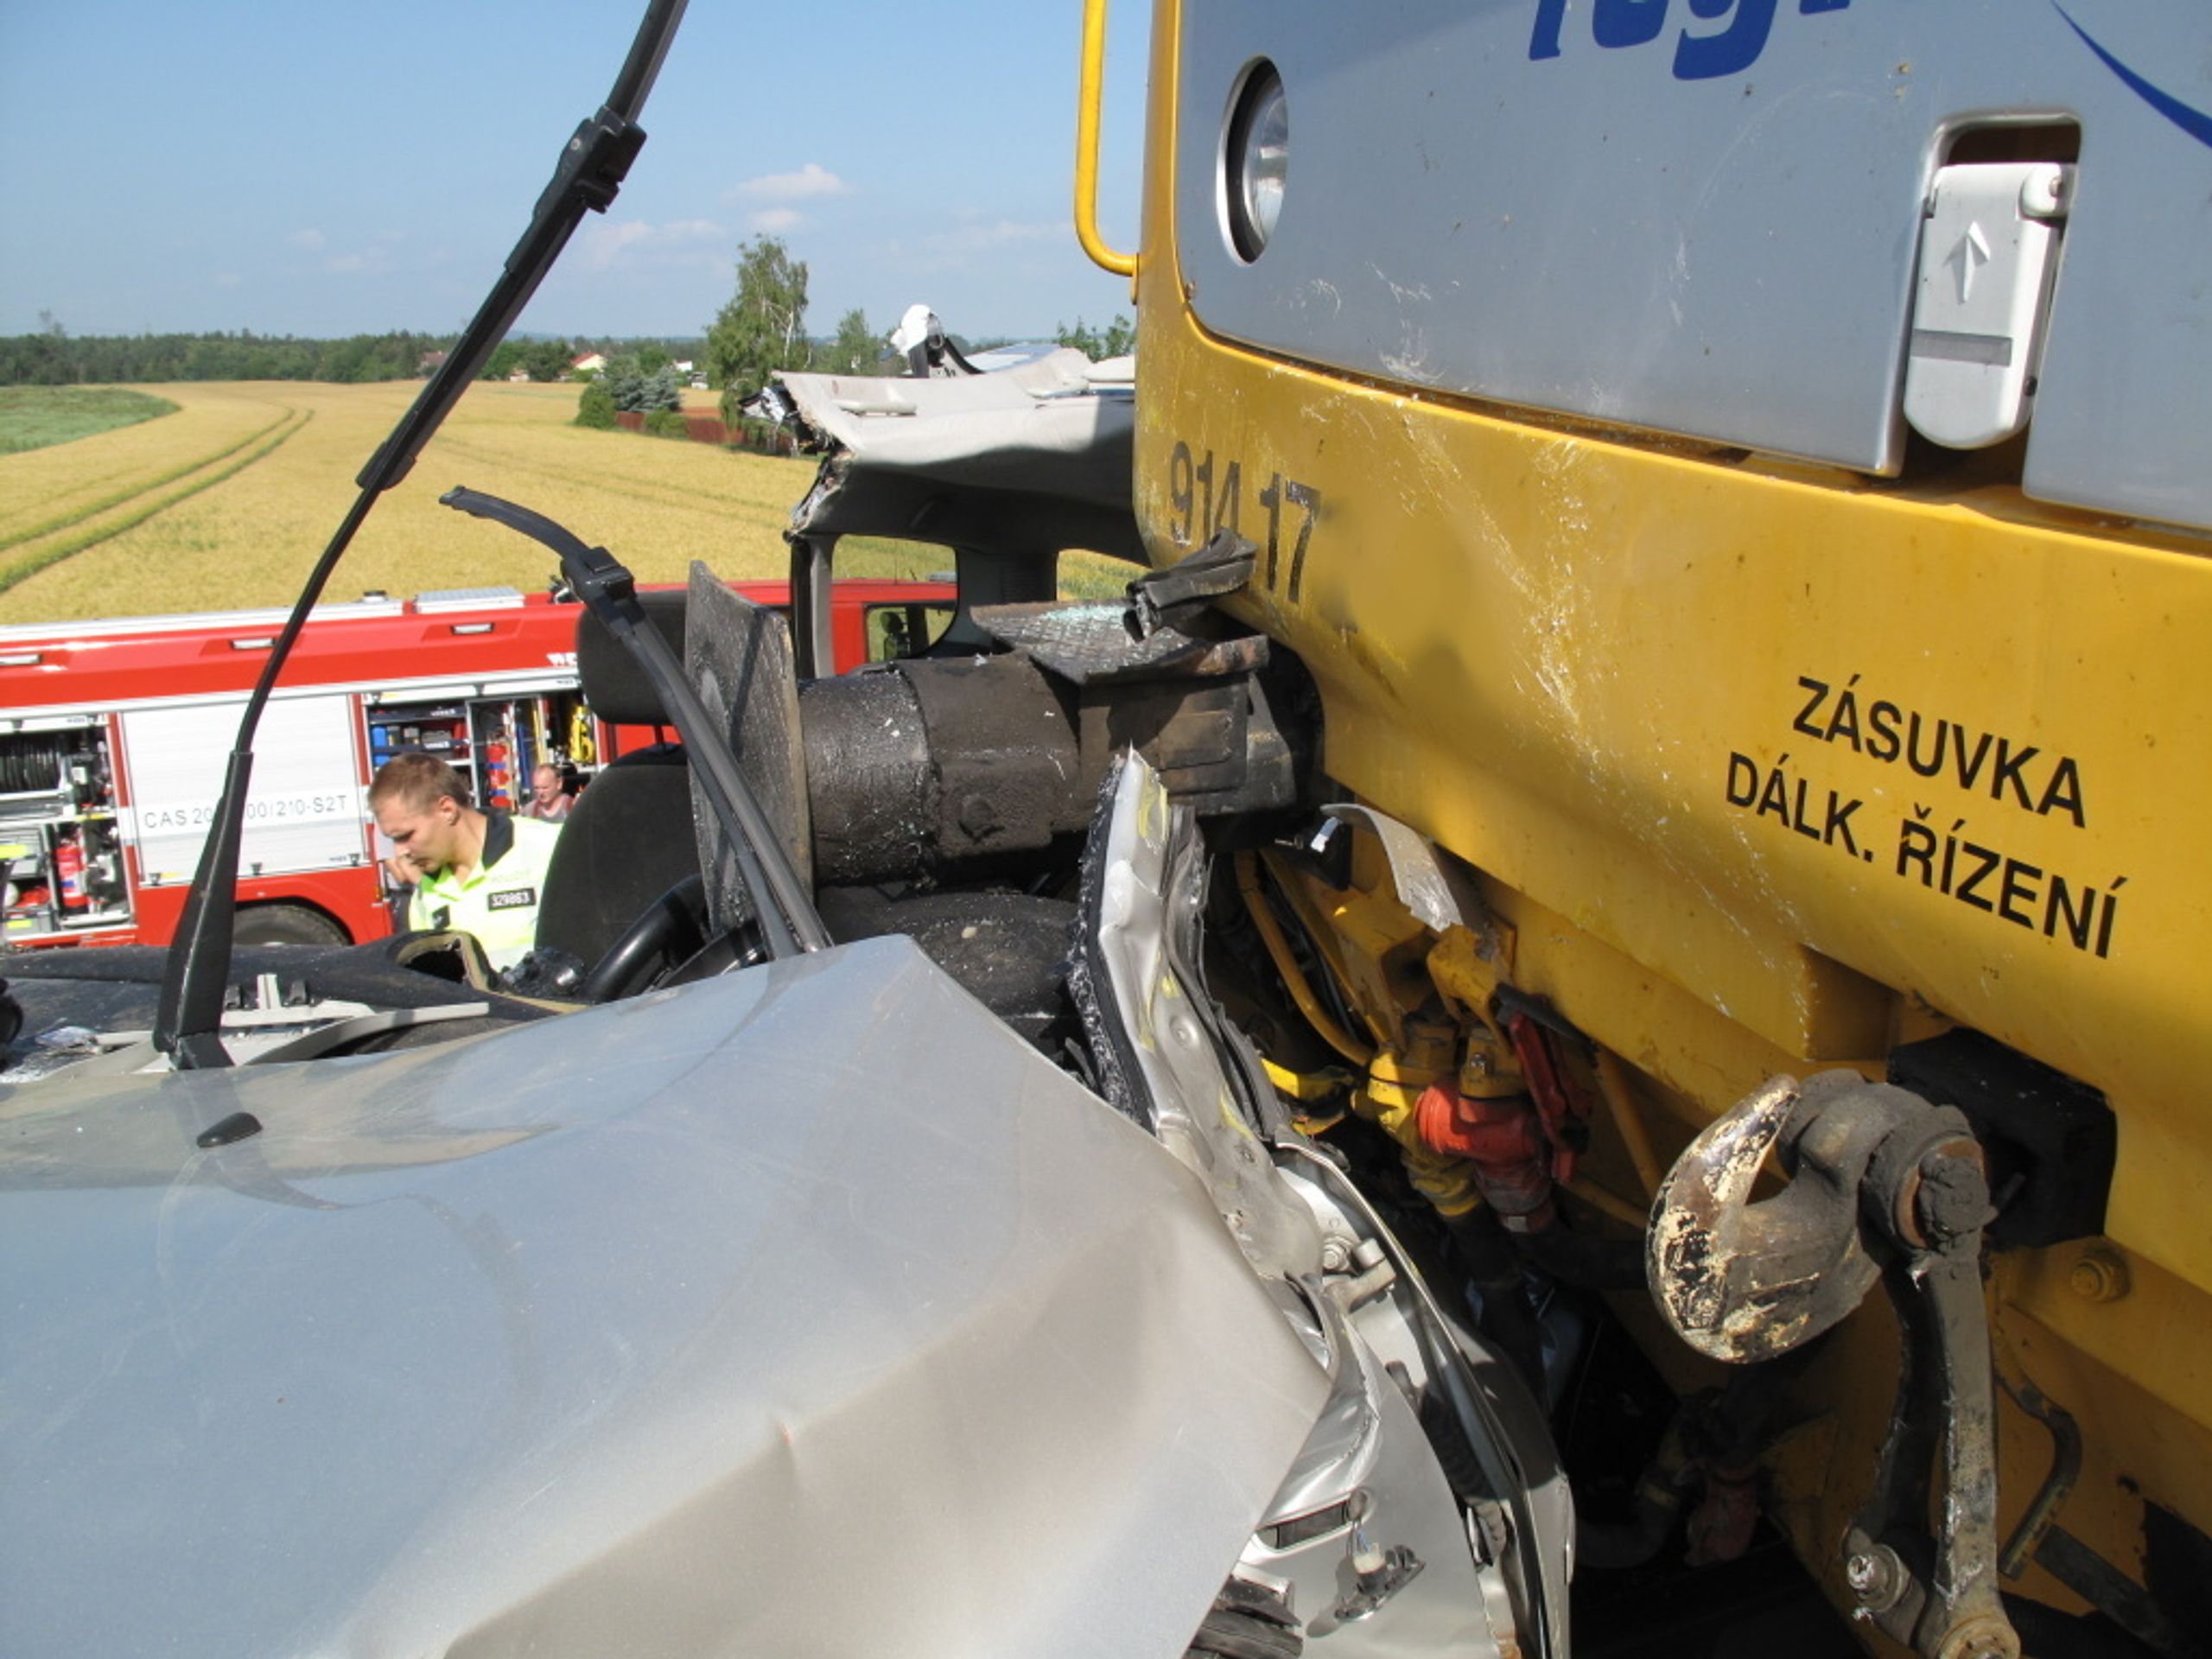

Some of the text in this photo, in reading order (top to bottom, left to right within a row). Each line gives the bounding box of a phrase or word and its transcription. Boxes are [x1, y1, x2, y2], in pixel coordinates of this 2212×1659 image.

[1170, 440, 1321, 603] 914 17
[144, 810, 188, 829] CAS
[1793, 673, 2087, 830] ZÁSUVKA
[1726, 751, 2129, 960] DÁLK. ŘÍZENÍ
